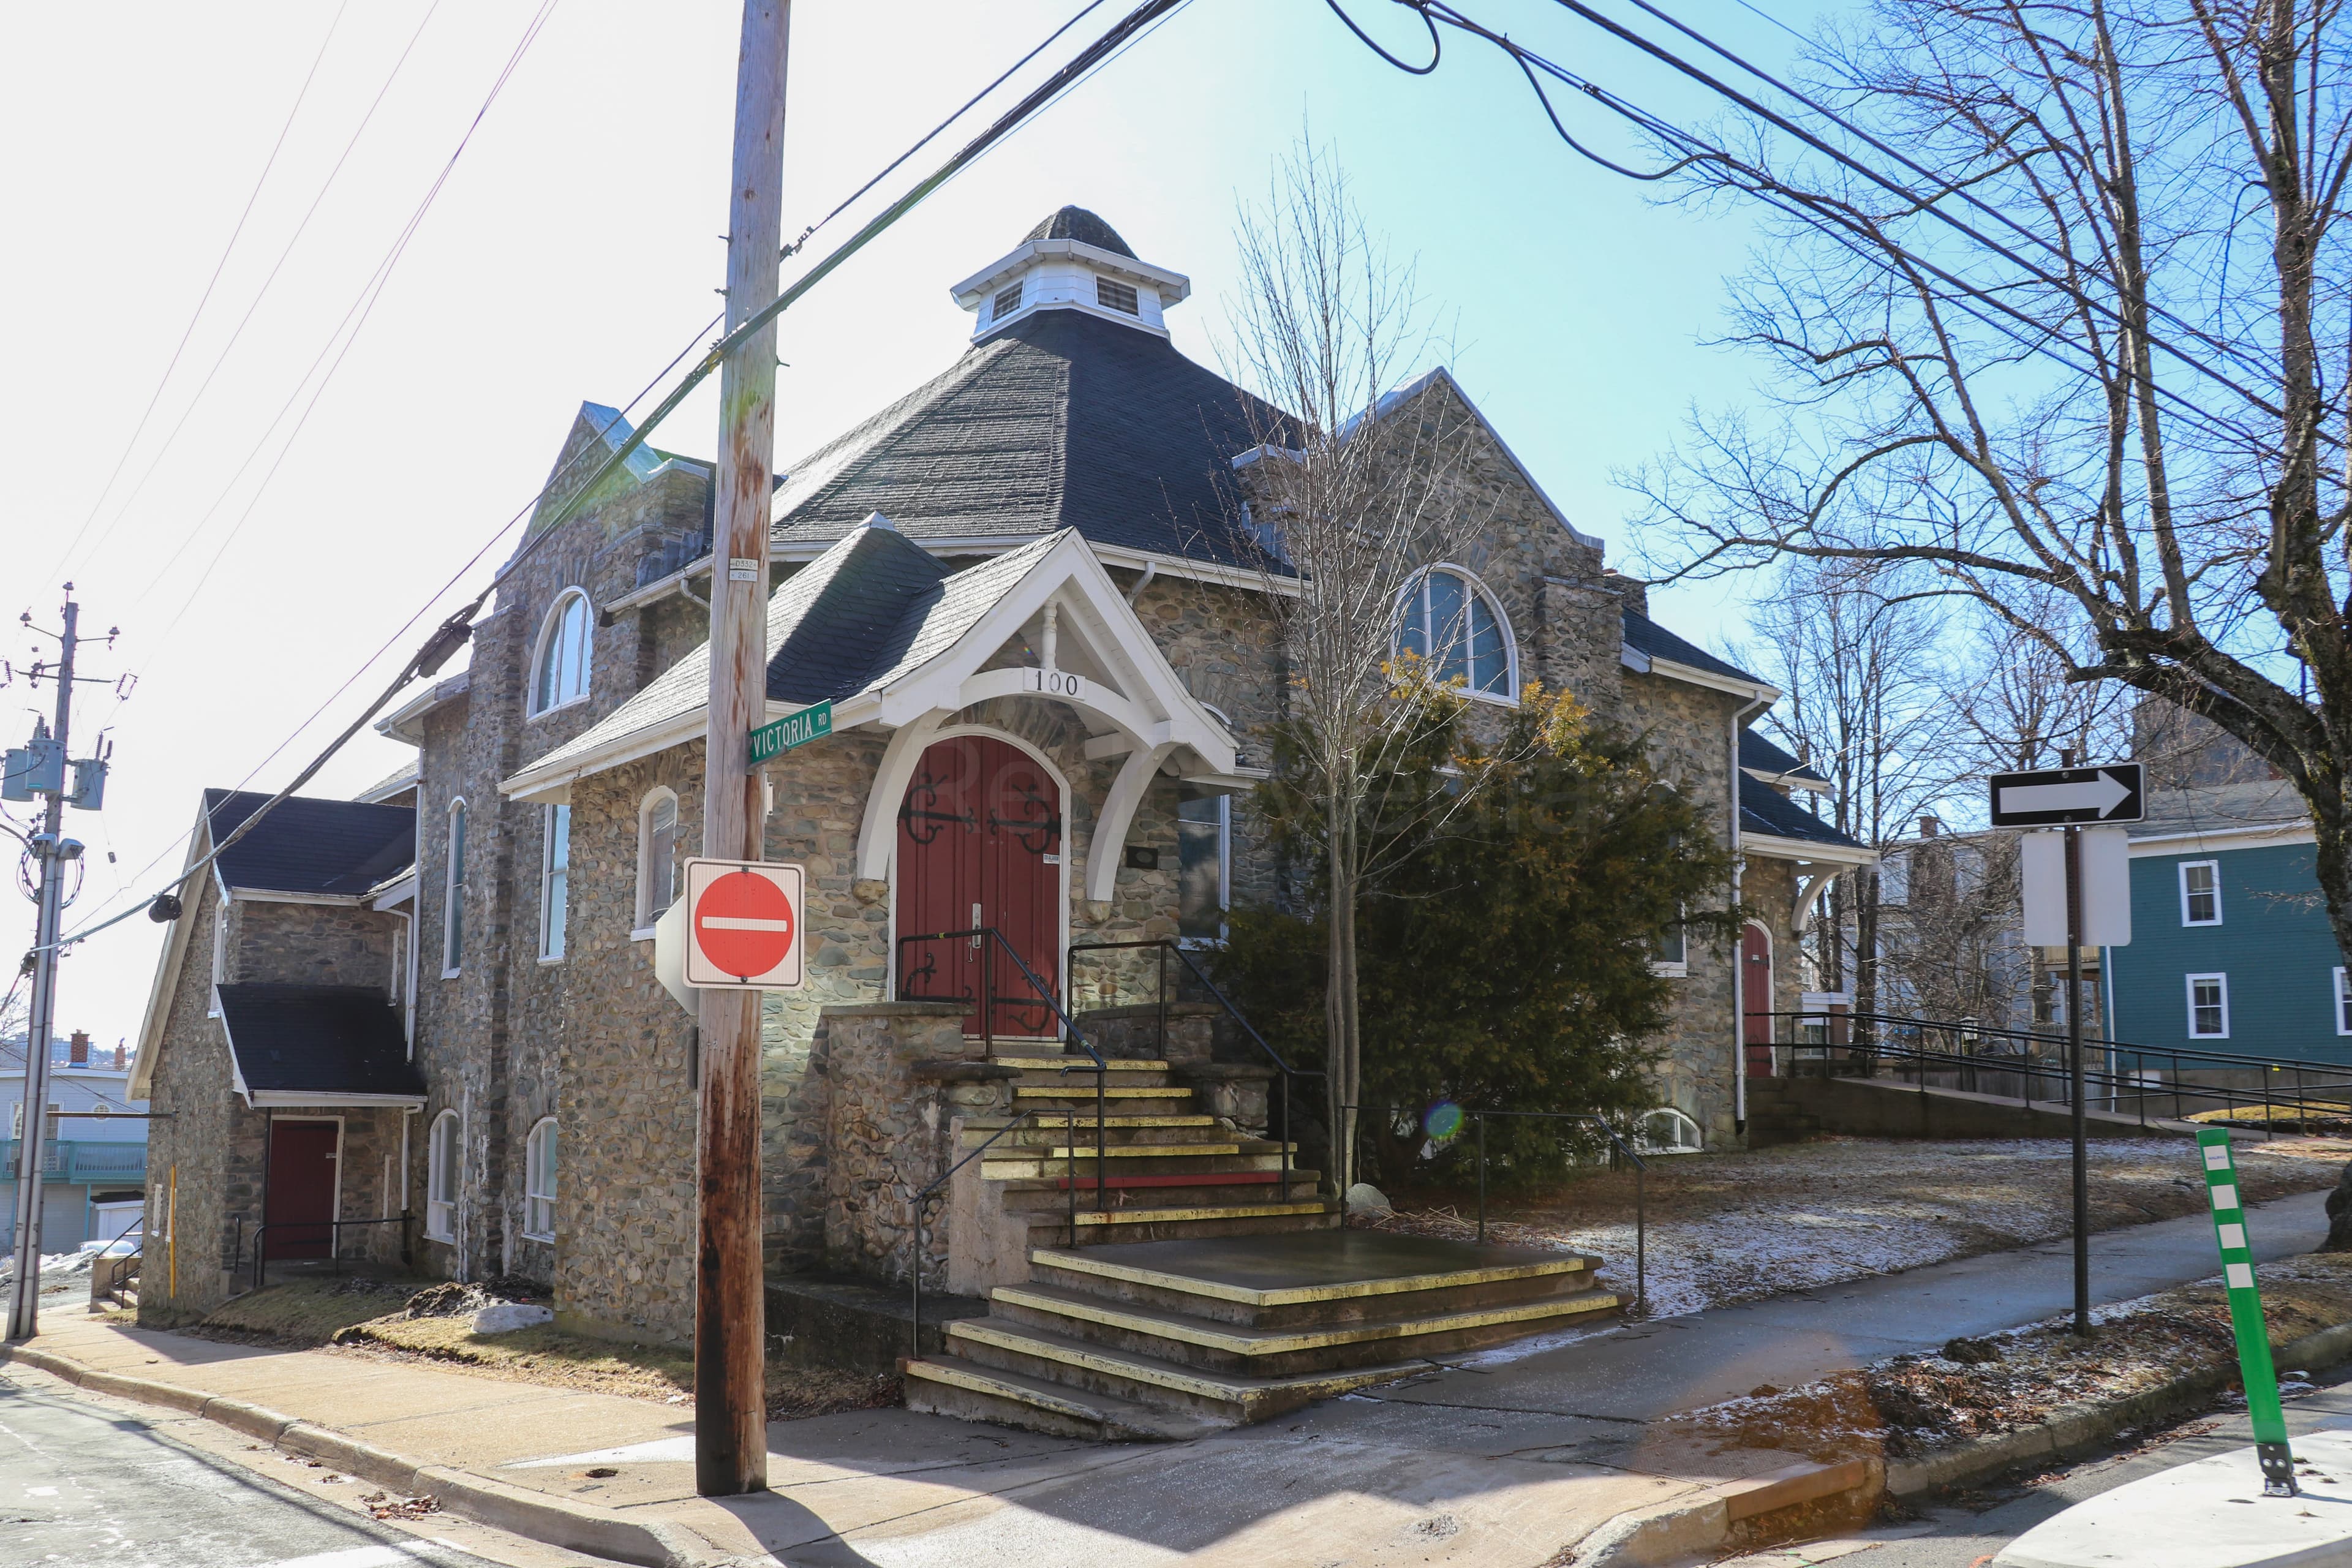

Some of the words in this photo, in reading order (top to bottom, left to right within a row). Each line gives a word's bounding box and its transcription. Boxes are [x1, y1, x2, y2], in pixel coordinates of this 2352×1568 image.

[1036, 671, 1077, 695] 100
[753, 713, 813, 757] VICTORIA
[818, 712, 827, 726] RD
